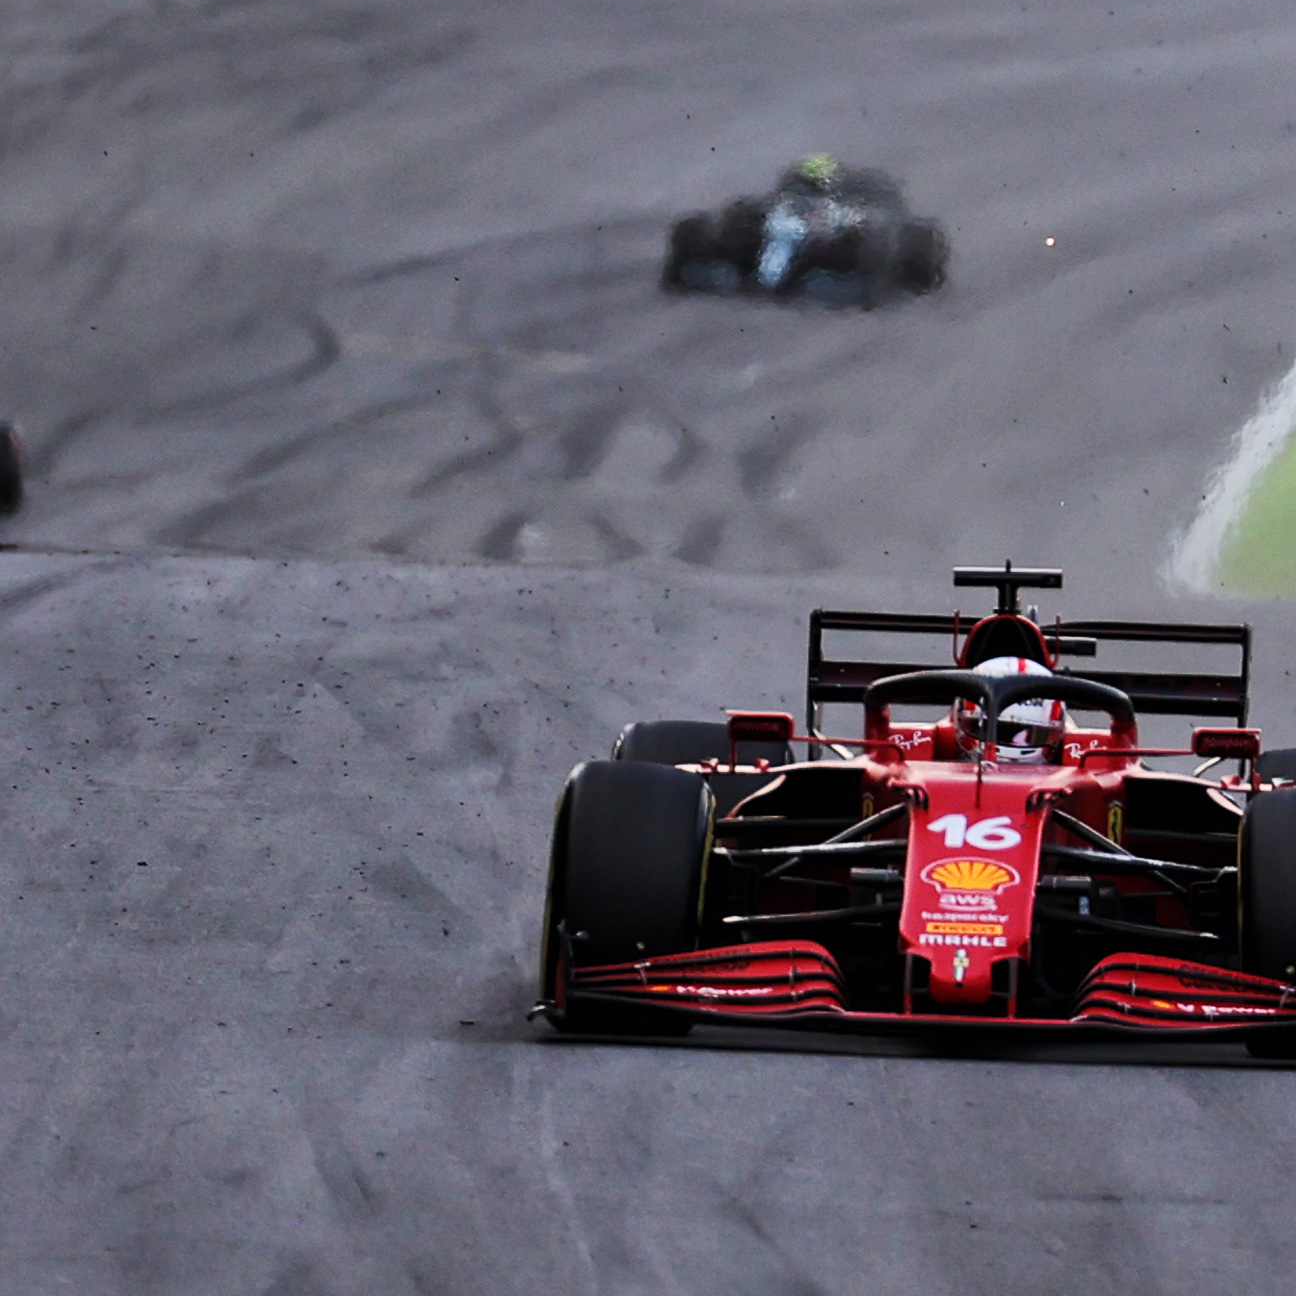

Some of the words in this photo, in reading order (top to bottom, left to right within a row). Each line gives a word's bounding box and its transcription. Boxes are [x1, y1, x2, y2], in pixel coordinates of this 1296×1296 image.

[926, 813, 1022, 850] 16
[939, 894, 996, 906] aws
[918, 933, 1008, 947] MAHLE
